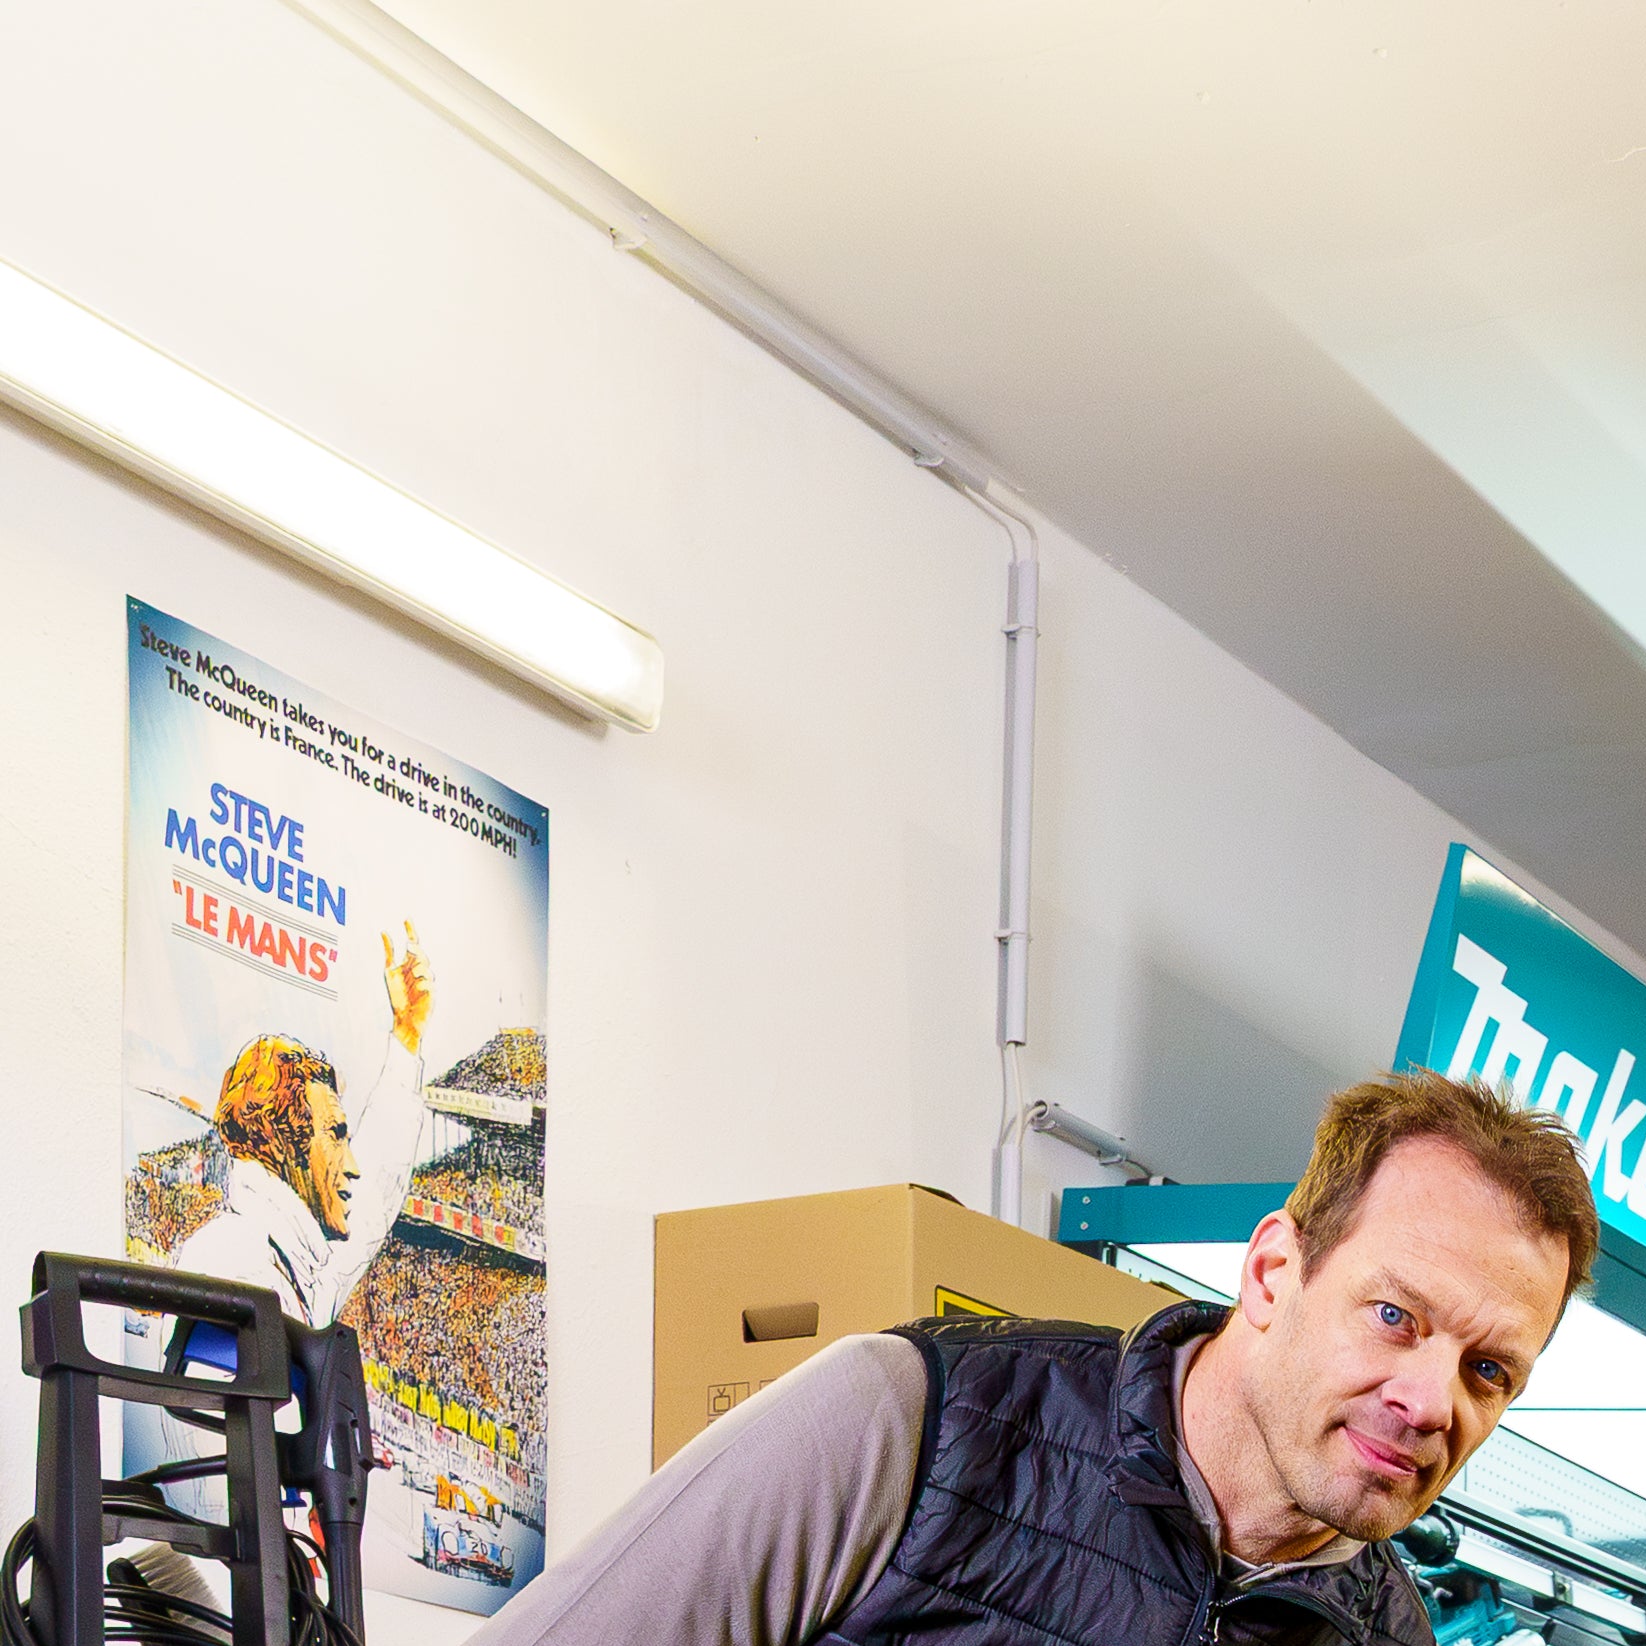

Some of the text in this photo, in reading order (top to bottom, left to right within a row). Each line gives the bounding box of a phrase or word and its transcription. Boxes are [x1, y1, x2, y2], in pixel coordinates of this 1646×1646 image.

[139, 621, 191, 667] Steve
[196, 651, 278, 712] McQueen
[283, 698, 324, 735] takes
[328, 723, 358, 752] you
[362, 736, 384, 764] for
[387, 754, 396, 771] a
[400, 757, 439, 793] drive
[443, 776, 457, 801] in
[461, 786, 484, 814] the
[165, 664, 517, 859] The country is France. The drive is at 200 MPH!
[165, 808, 346, 927] McQUEEN
[210, 782, 304, 863] STEVE
